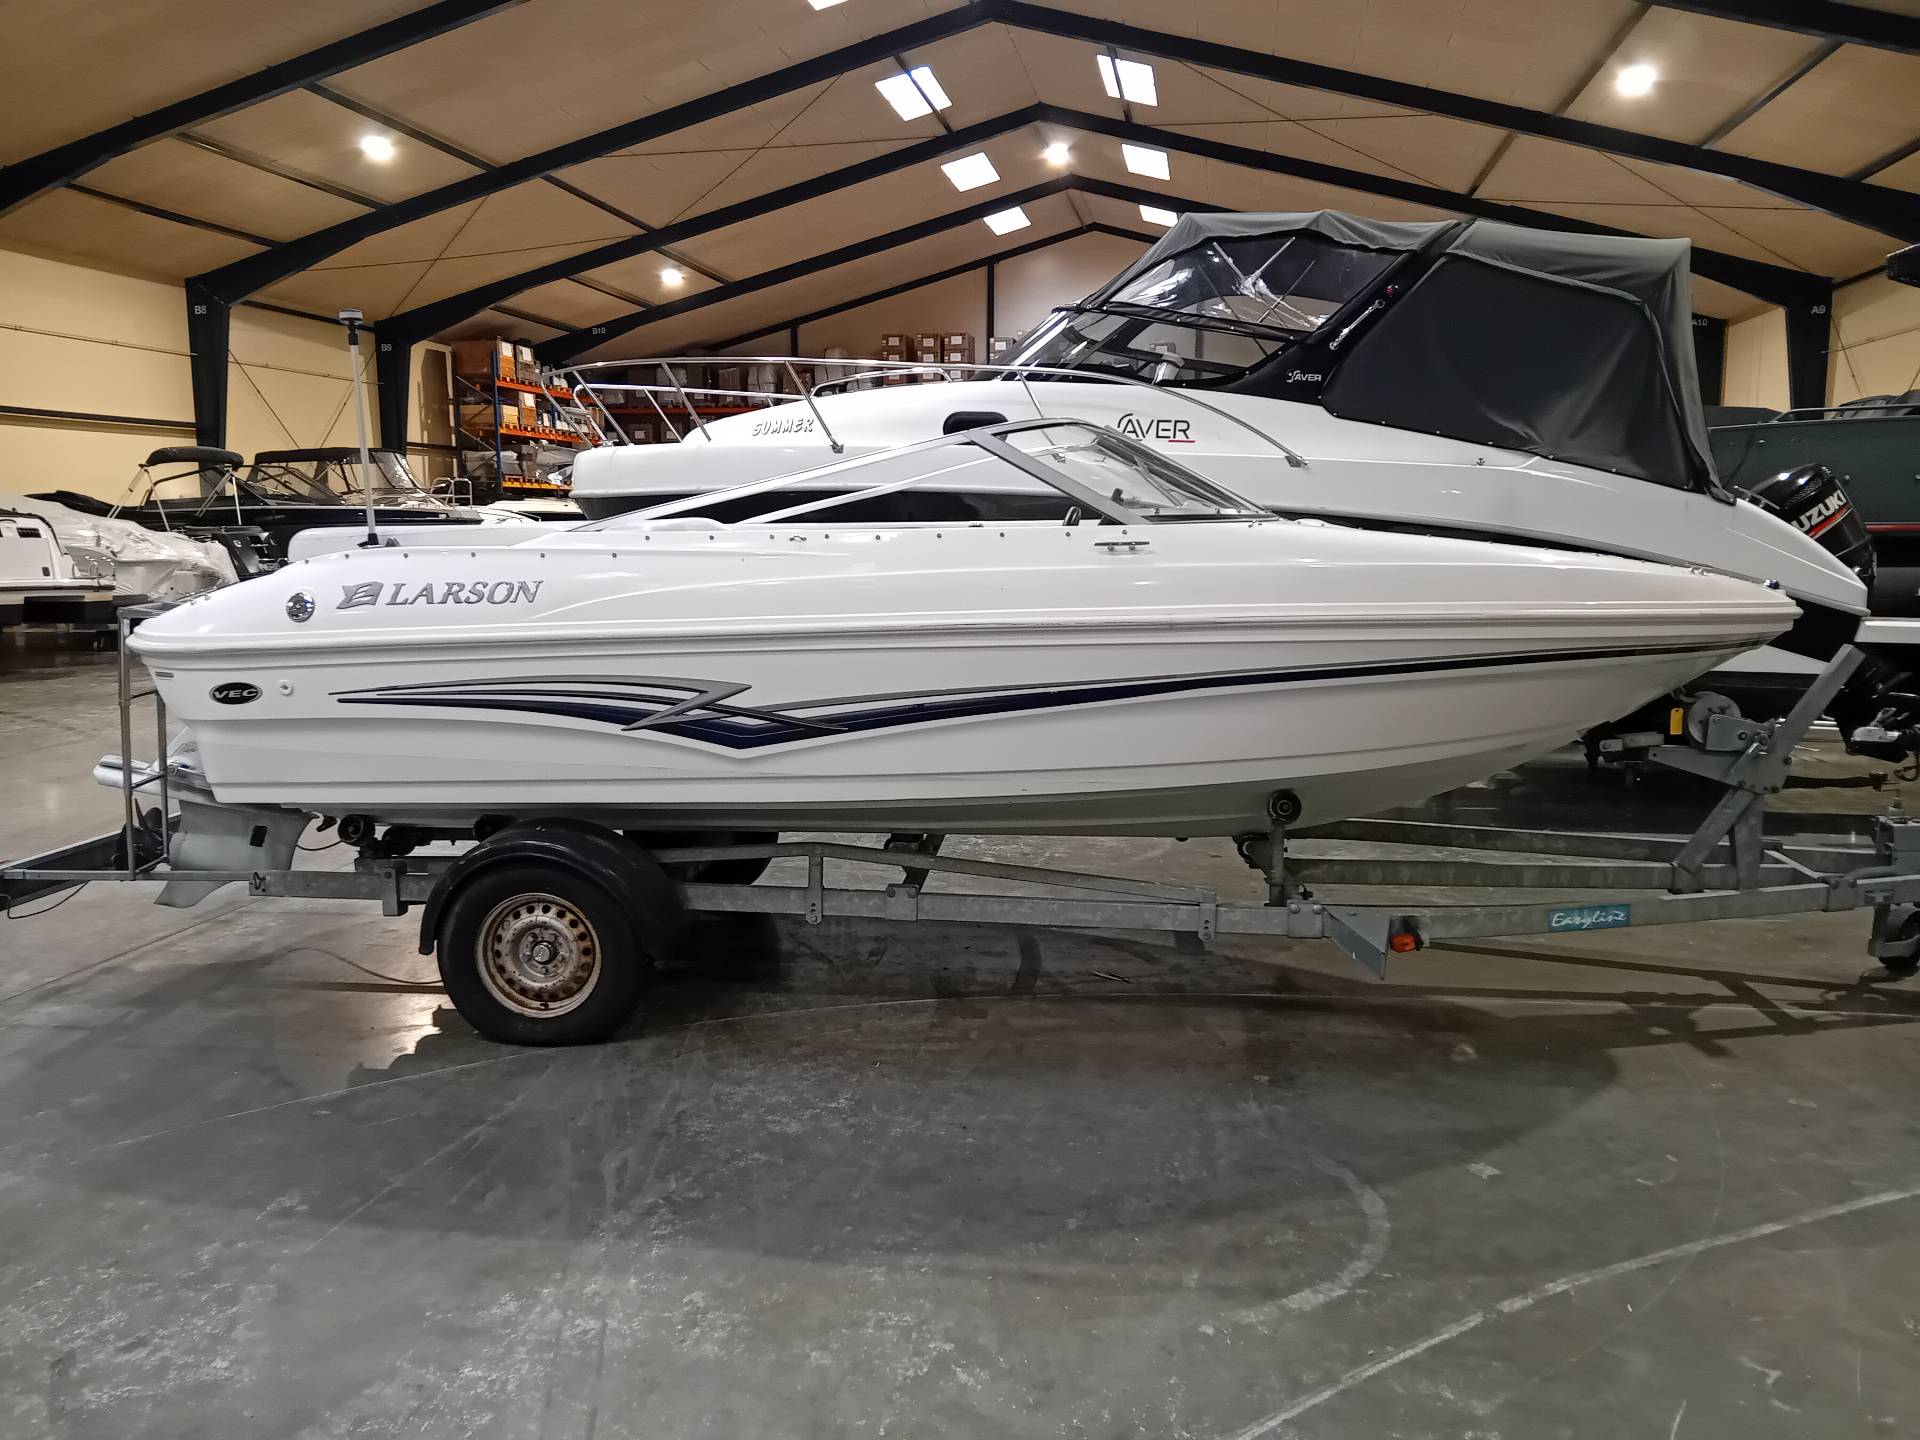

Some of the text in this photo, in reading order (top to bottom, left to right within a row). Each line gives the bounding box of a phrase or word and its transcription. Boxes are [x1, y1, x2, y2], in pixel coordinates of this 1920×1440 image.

[194, 305, 207, 315] B8
[1811, 304, 1826, 314] A9
[592, 327, 606, 335] B10
[381, 343, 392, 351] B9
[751, 418, 815, 437] SUMMER
[1790, 489, 1847, 532] UZUKI
[385, 580, 544, 606] LARSON
[213, 688, 258, 699] VEC
